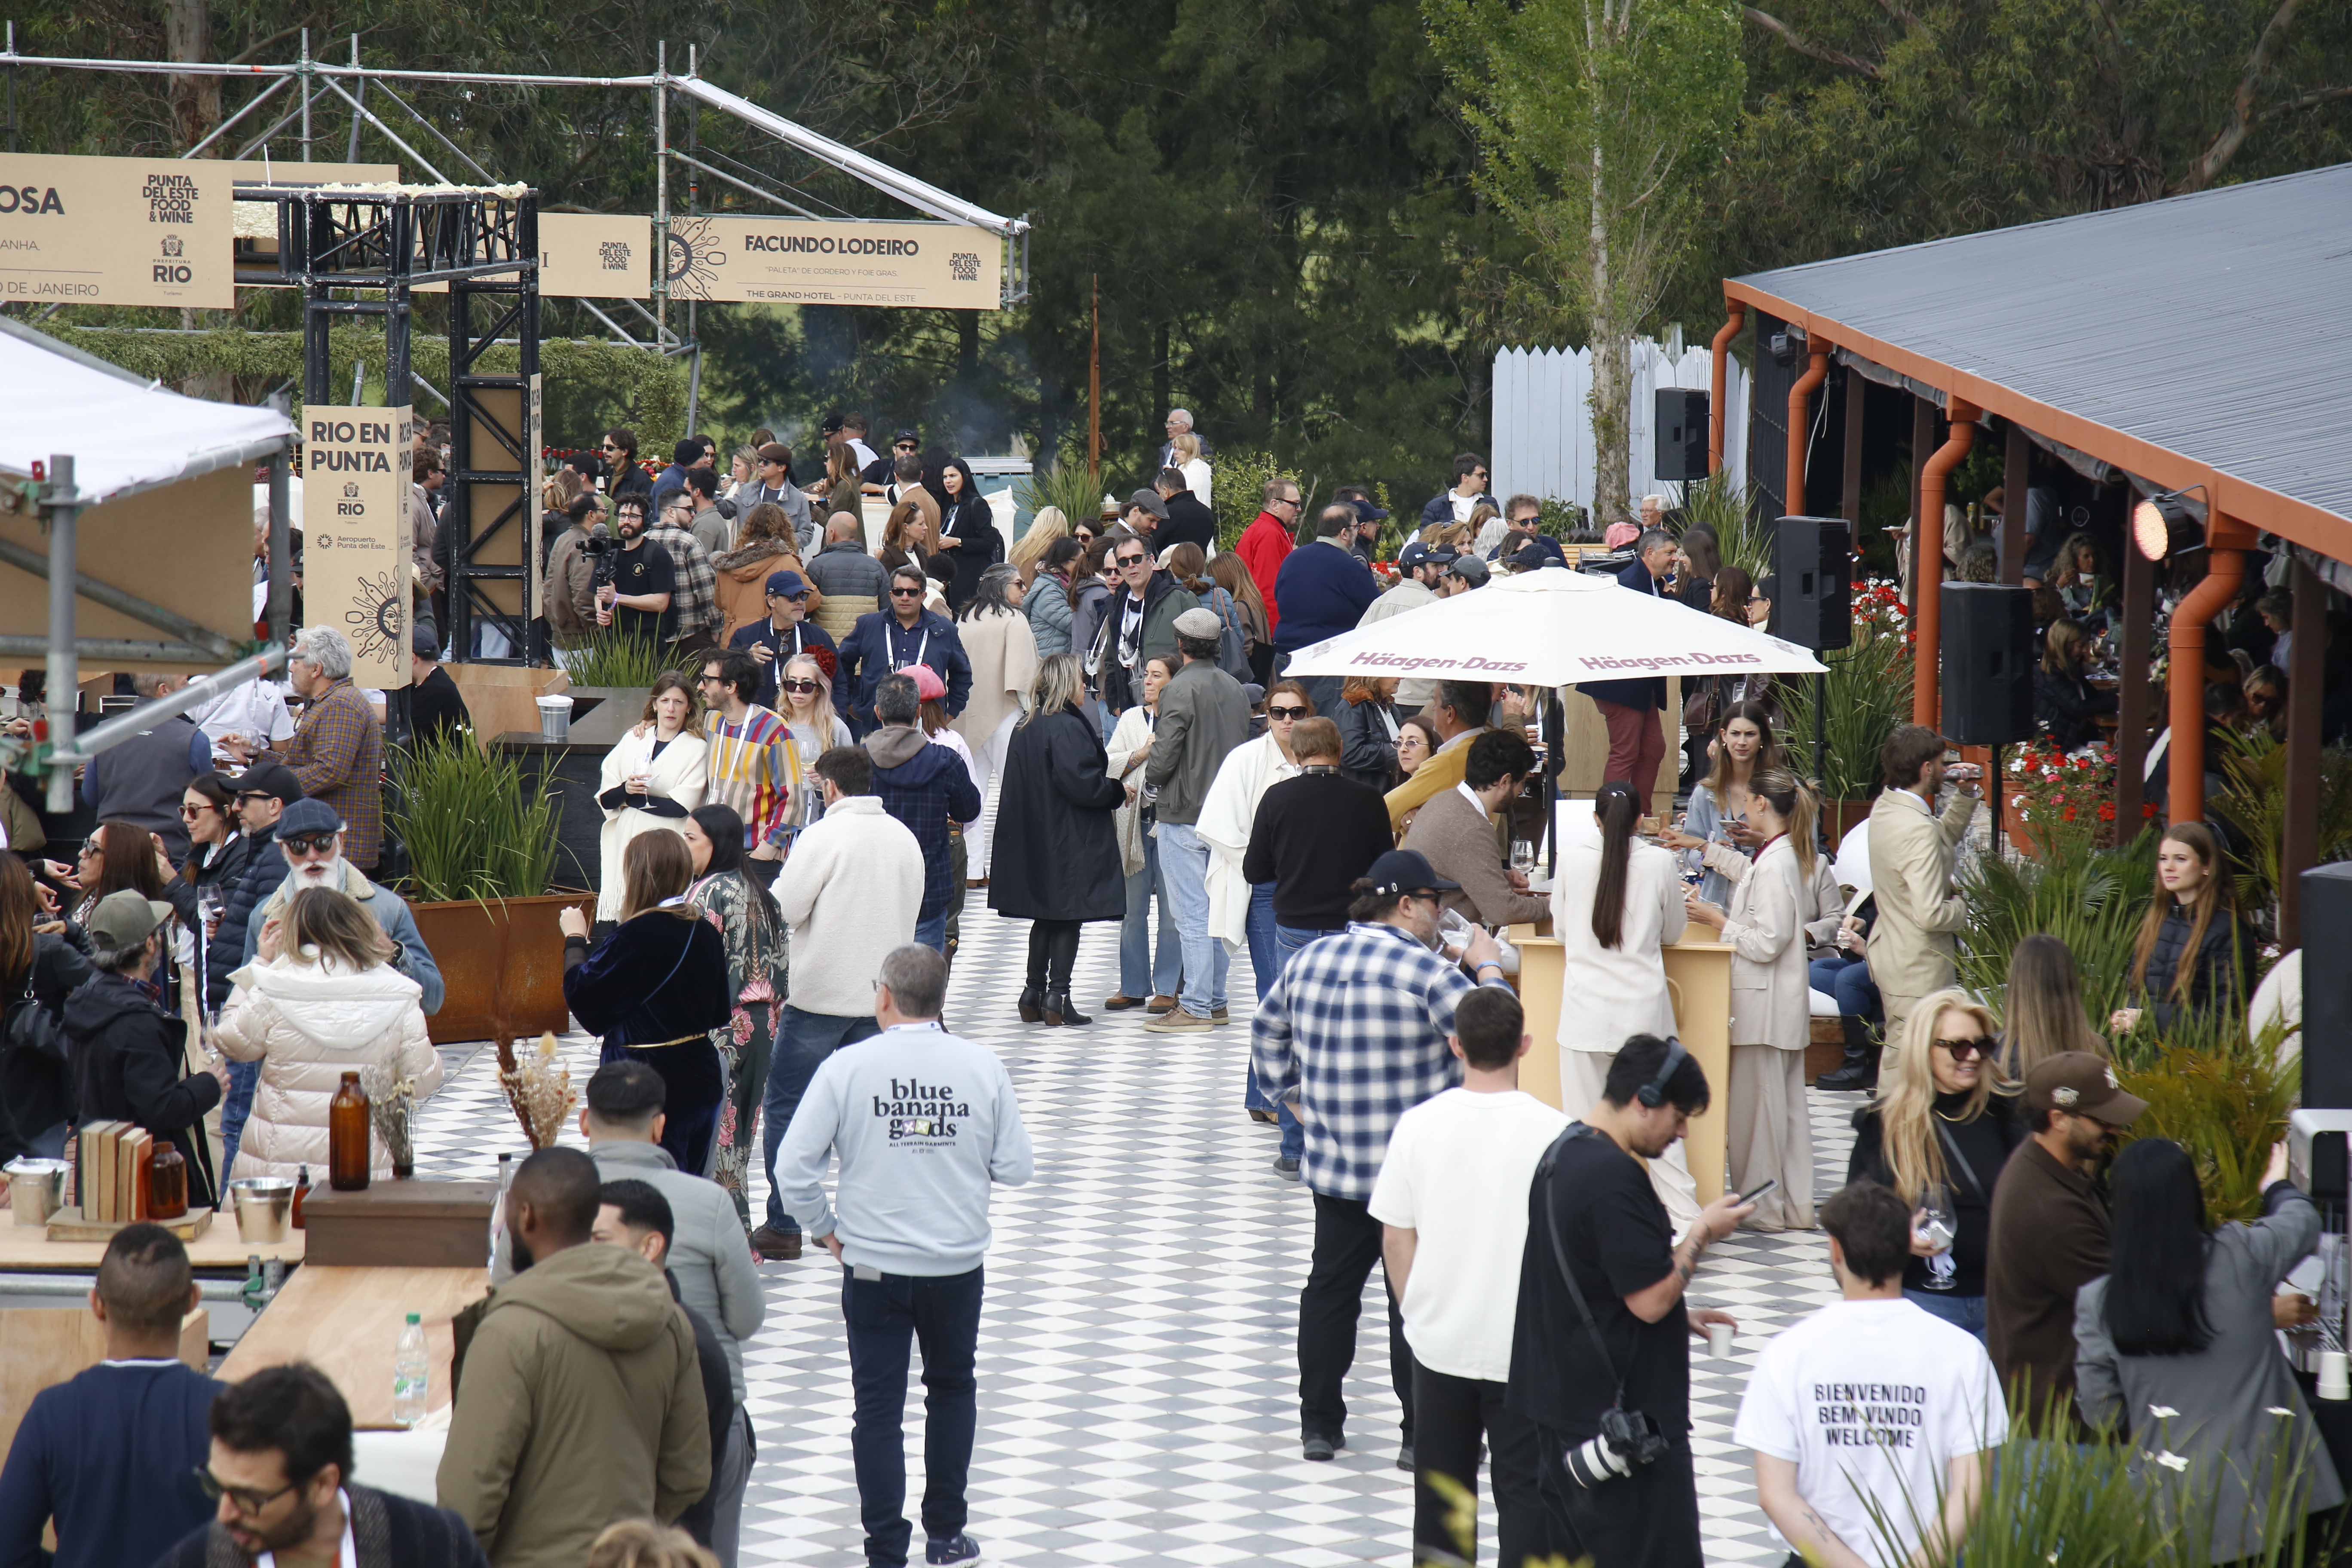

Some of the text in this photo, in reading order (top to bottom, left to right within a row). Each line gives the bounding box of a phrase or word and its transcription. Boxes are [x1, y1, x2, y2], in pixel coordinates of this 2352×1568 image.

[148, 174, 193, 187] PUNTA
[0, 185, 65, 215] OSA
[143, 186, 199, 200] DEL ESTE
[151, 199, 191, 211] FOOD
[149, 210, 193, 224] & WINE
[0, 239, 40, 251] ANHA.
[745, 235, 919, 256] FACUNDO LODEIRO
[952, 252, 978, 260] PUNTA
[153, 265, 192, 283] RIO
[8, 282, 28, 294] DE
[32, 282, 99, 296] JANEIRO
[312, 421, 390, 444] RIO EN
[311, 450, 391, 472] PUNTA
[399, 450, 412, 472] PUNTA
[337, 503, 364, 515] RIO
[1349, 652, 1529, 671] Häagen-Dazs
[1578, 652, 1762, 670] Häagen-Dazs
[890, 1078, 954, 1101] blue
[873, 1095, 971, 1118] banana
[1815, 1384, 1926, 1404] BIENVENIDO
[1826, 1428, 1915, 1449] WELCOME
